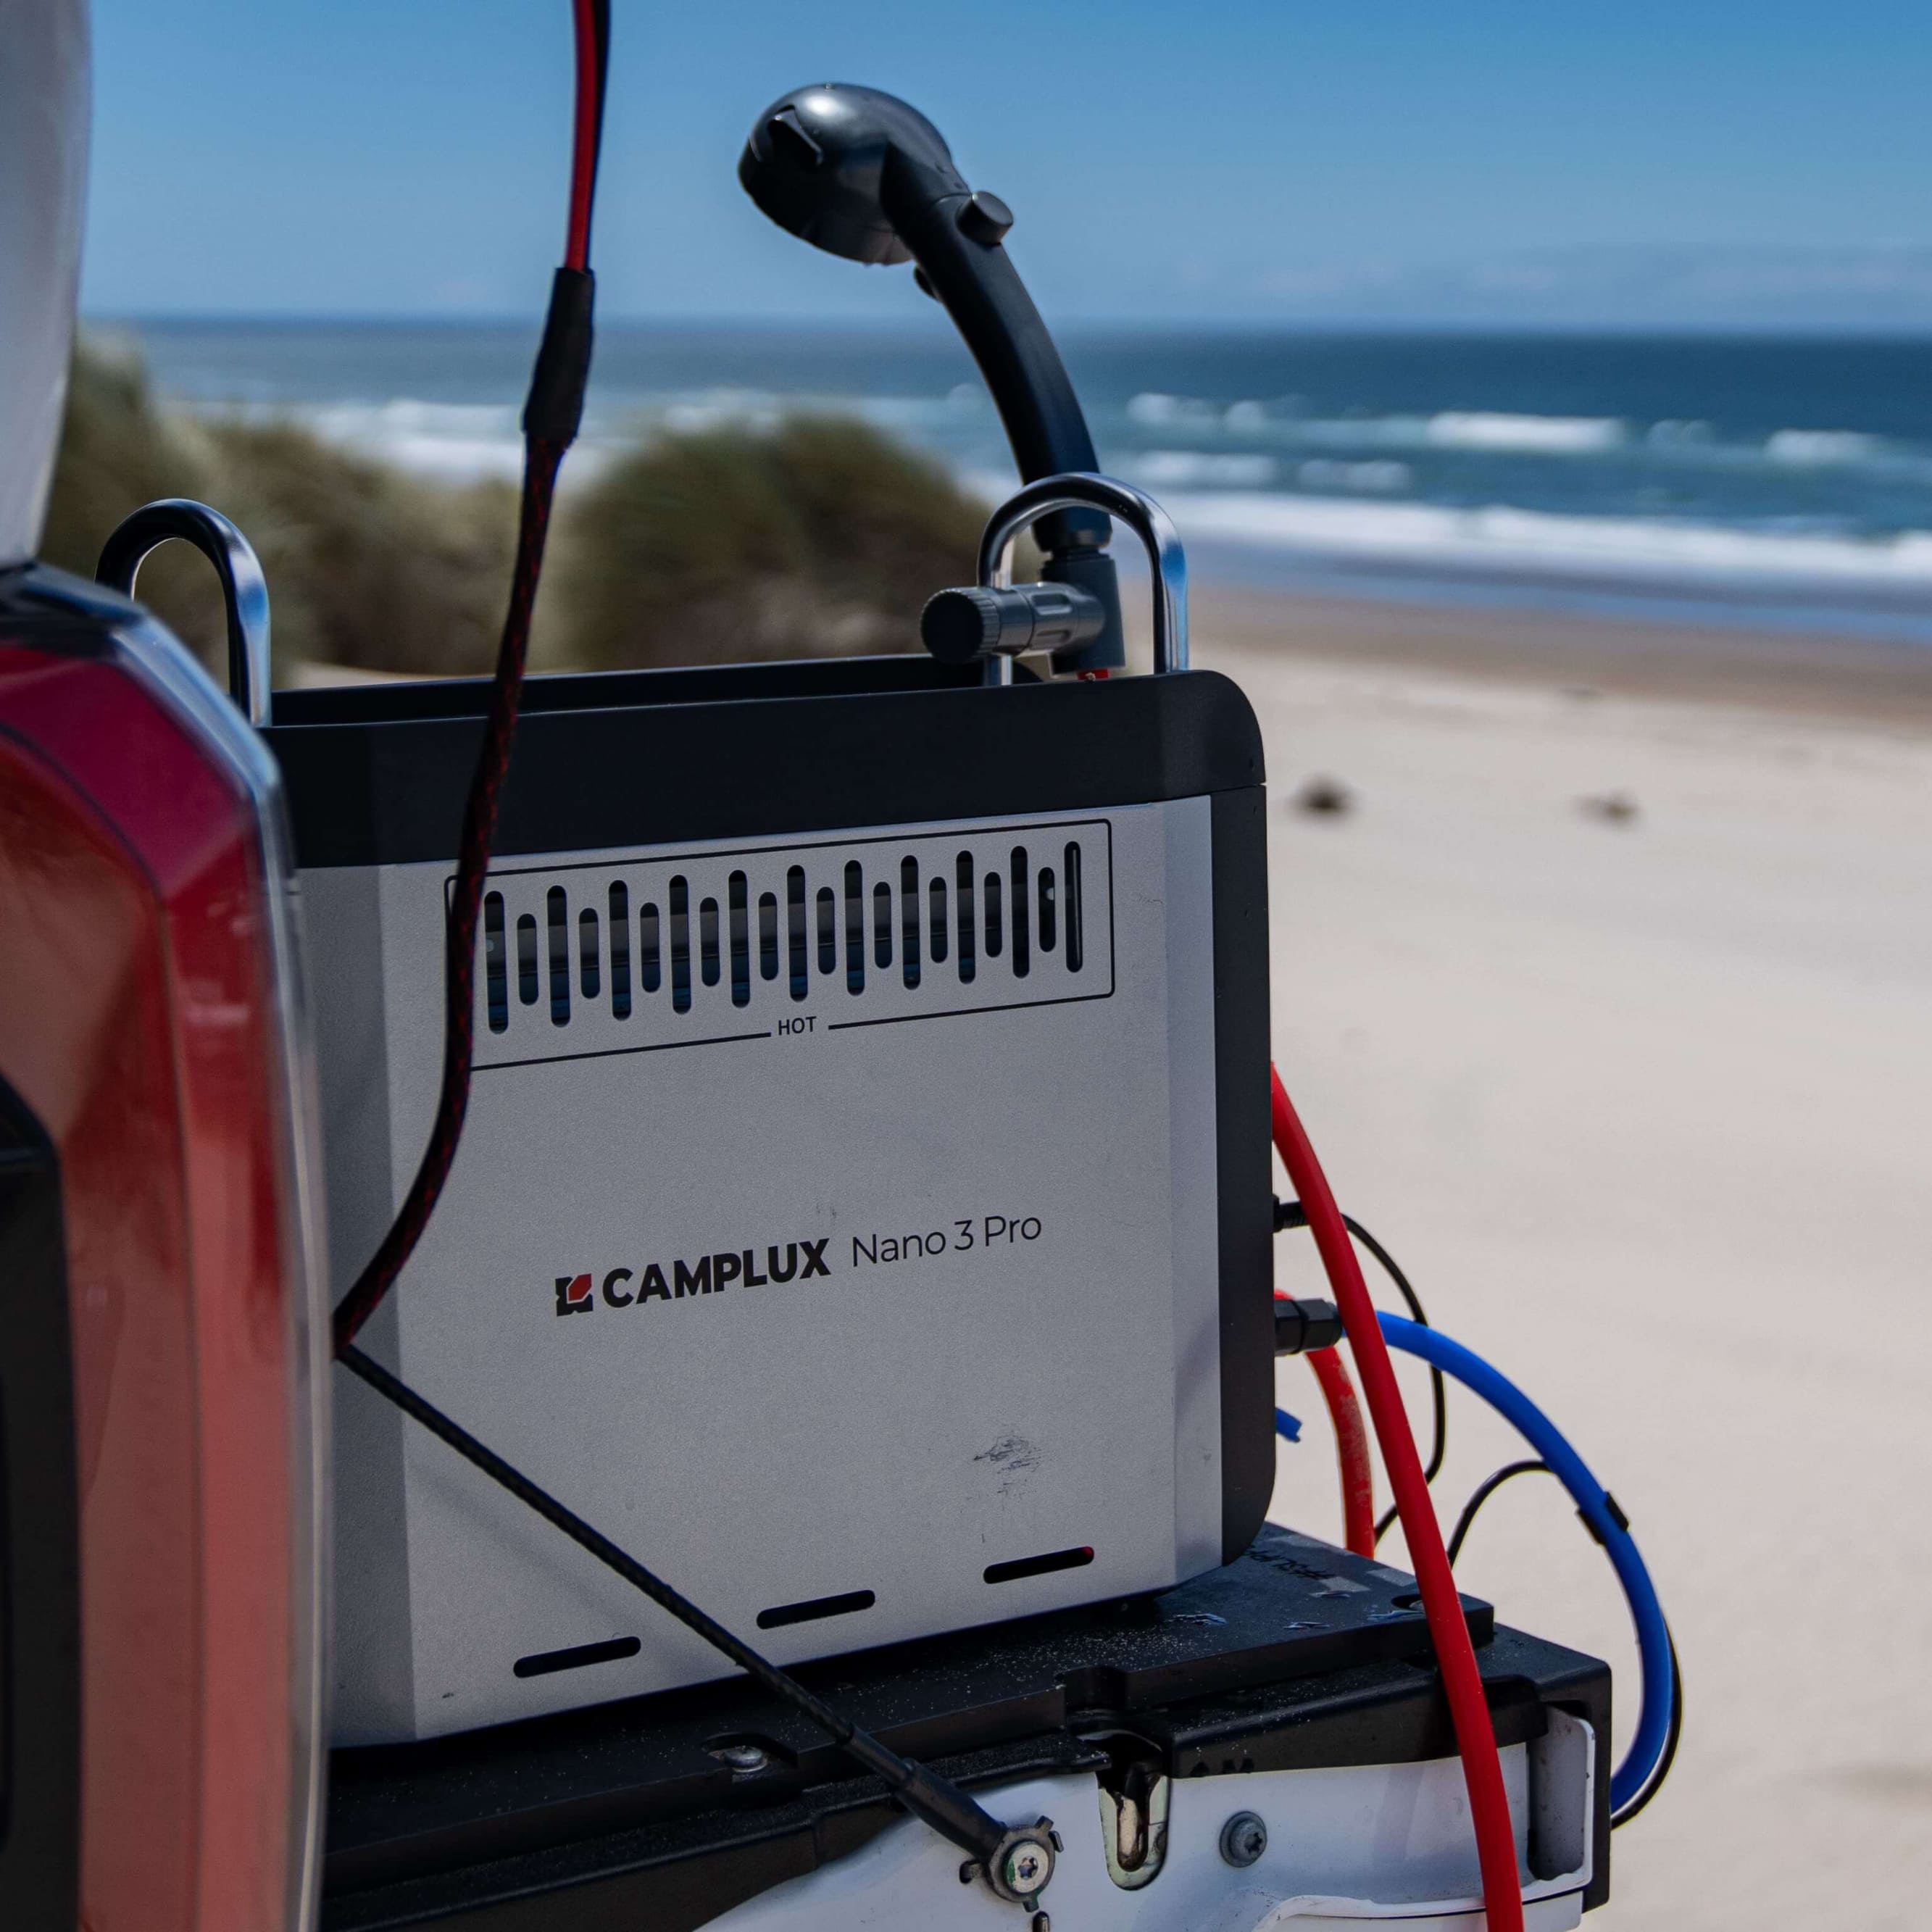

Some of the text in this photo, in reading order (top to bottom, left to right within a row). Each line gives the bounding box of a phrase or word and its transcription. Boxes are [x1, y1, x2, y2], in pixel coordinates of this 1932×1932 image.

[778, 1016, 817, 1036] HOT
[602, 1215, 1041, 1308] CAMPLUX Nano 3 Pro
